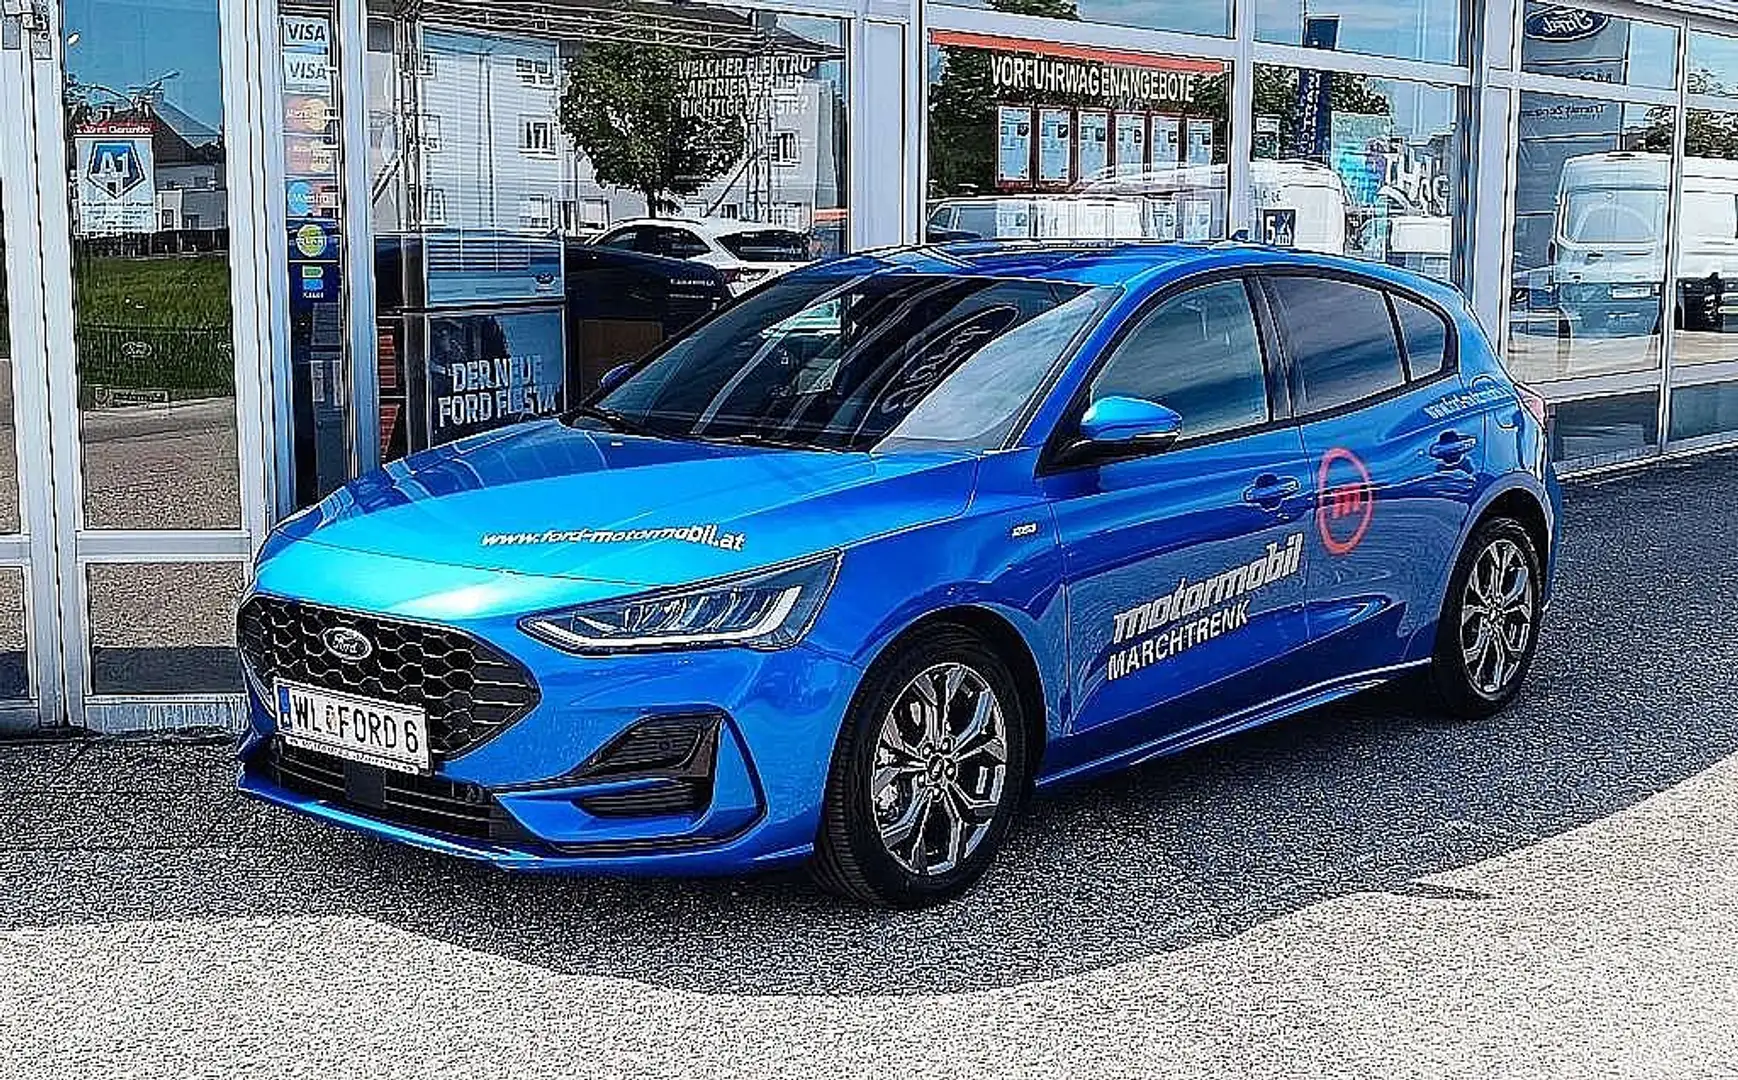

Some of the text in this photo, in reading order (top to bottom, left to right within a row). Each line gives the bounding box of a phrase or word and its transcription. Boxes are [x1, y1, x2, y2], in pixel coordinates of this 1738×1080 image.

[288, 24, 326, 41] VISA
[289, 62, 327, 79] VISA
[678, 57, 744, 79] WELCHER
[991, 53, 1196, 102] VORFÜHRWAGENANGEBOTE
[686, 77, 748, 99] ANTRIEB
[680, 96, 744, 118] RICHTIGE
[450, 359, 495, 393] DER
[438, 392, 492, 427] FORD
[482, 524, 746, 552] www.ford-motormobil.at
[1113, 532, 1303, 645] motormobil
[332, 633, 358, 653] Ford
[1107, 600, 1250, 681] MARCHTRENK
[292, 693, 322, 733] WL
[337, 704, 397, 748] FORD
[404, 720, 419, 754] 6
